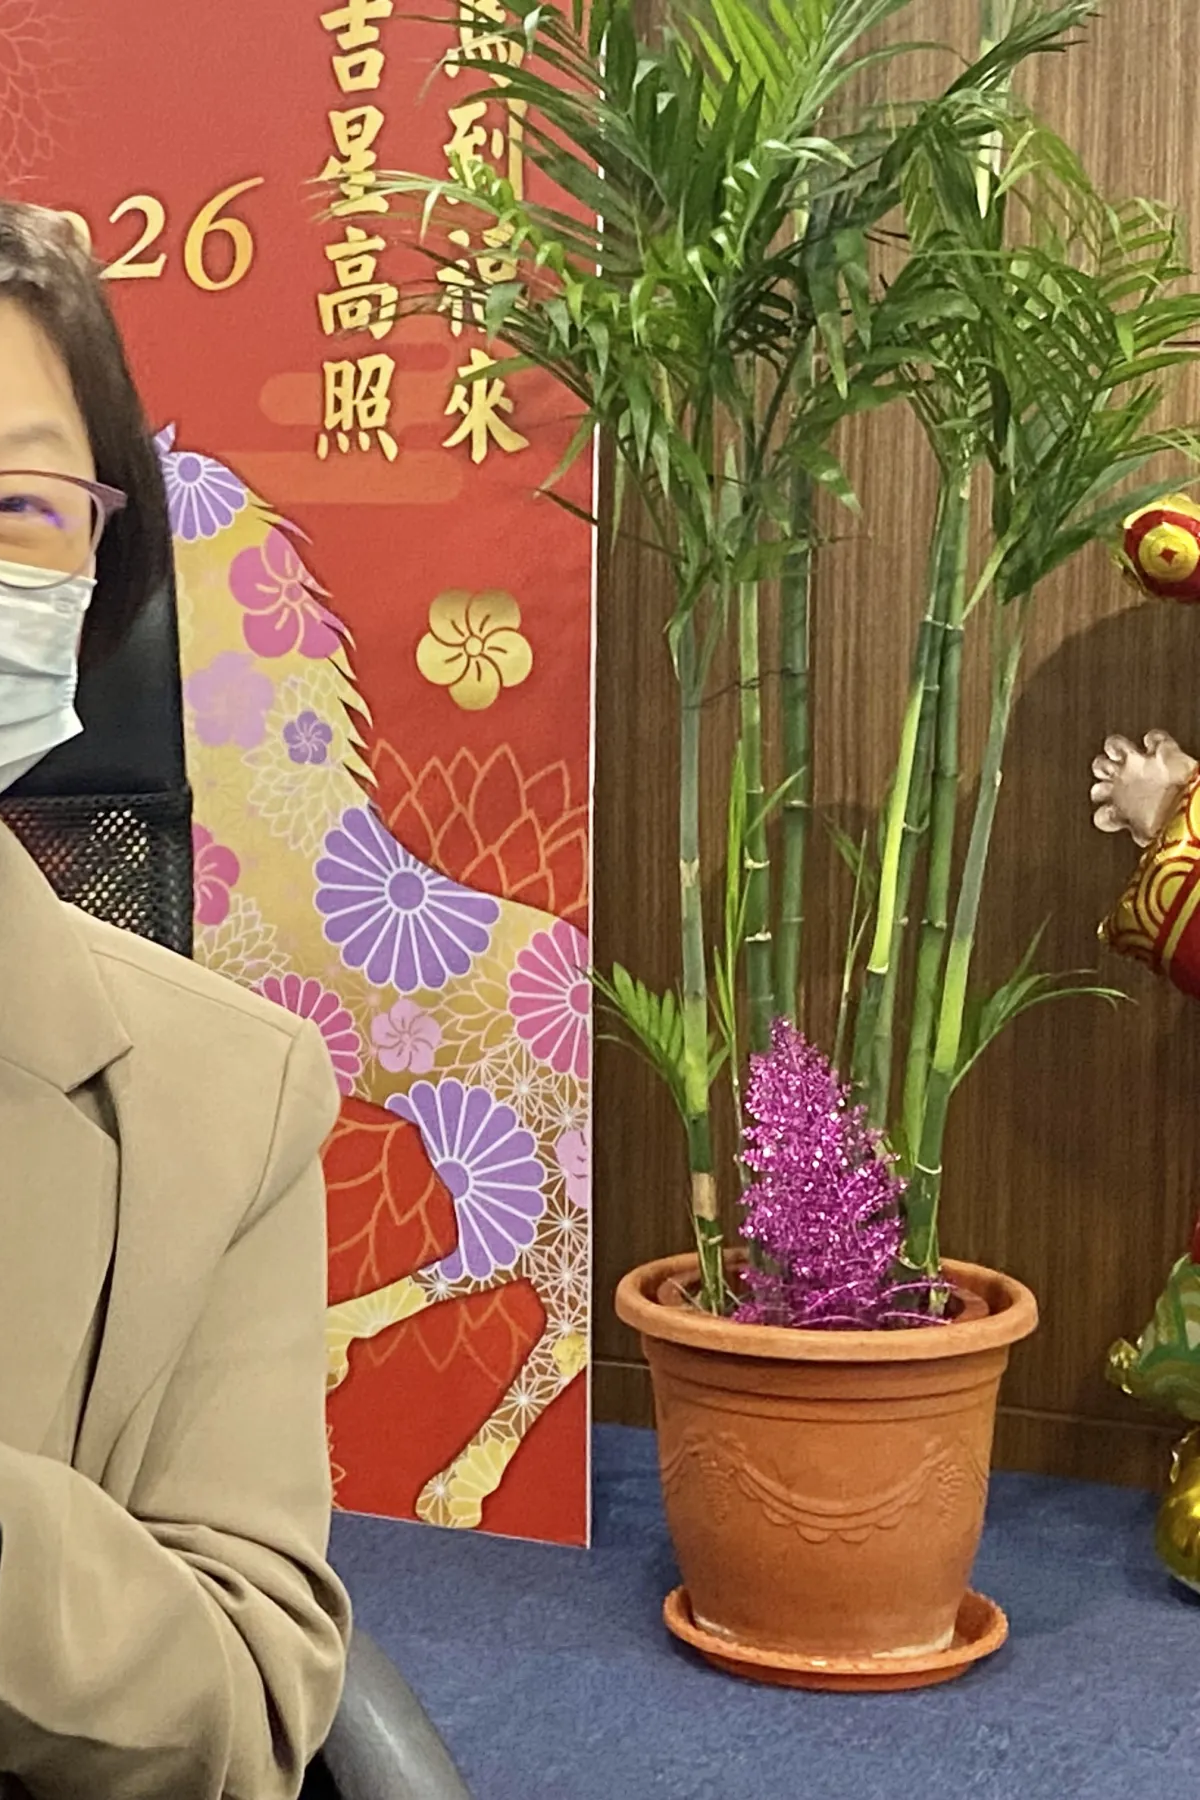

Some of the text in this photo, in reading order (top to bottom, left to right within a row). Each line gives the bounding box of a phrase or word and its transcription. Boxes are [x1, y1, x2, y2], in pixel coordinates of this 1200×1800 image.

[62, 176, 265, 291] 26
[316, 0, 400, 462] 吉星高照
